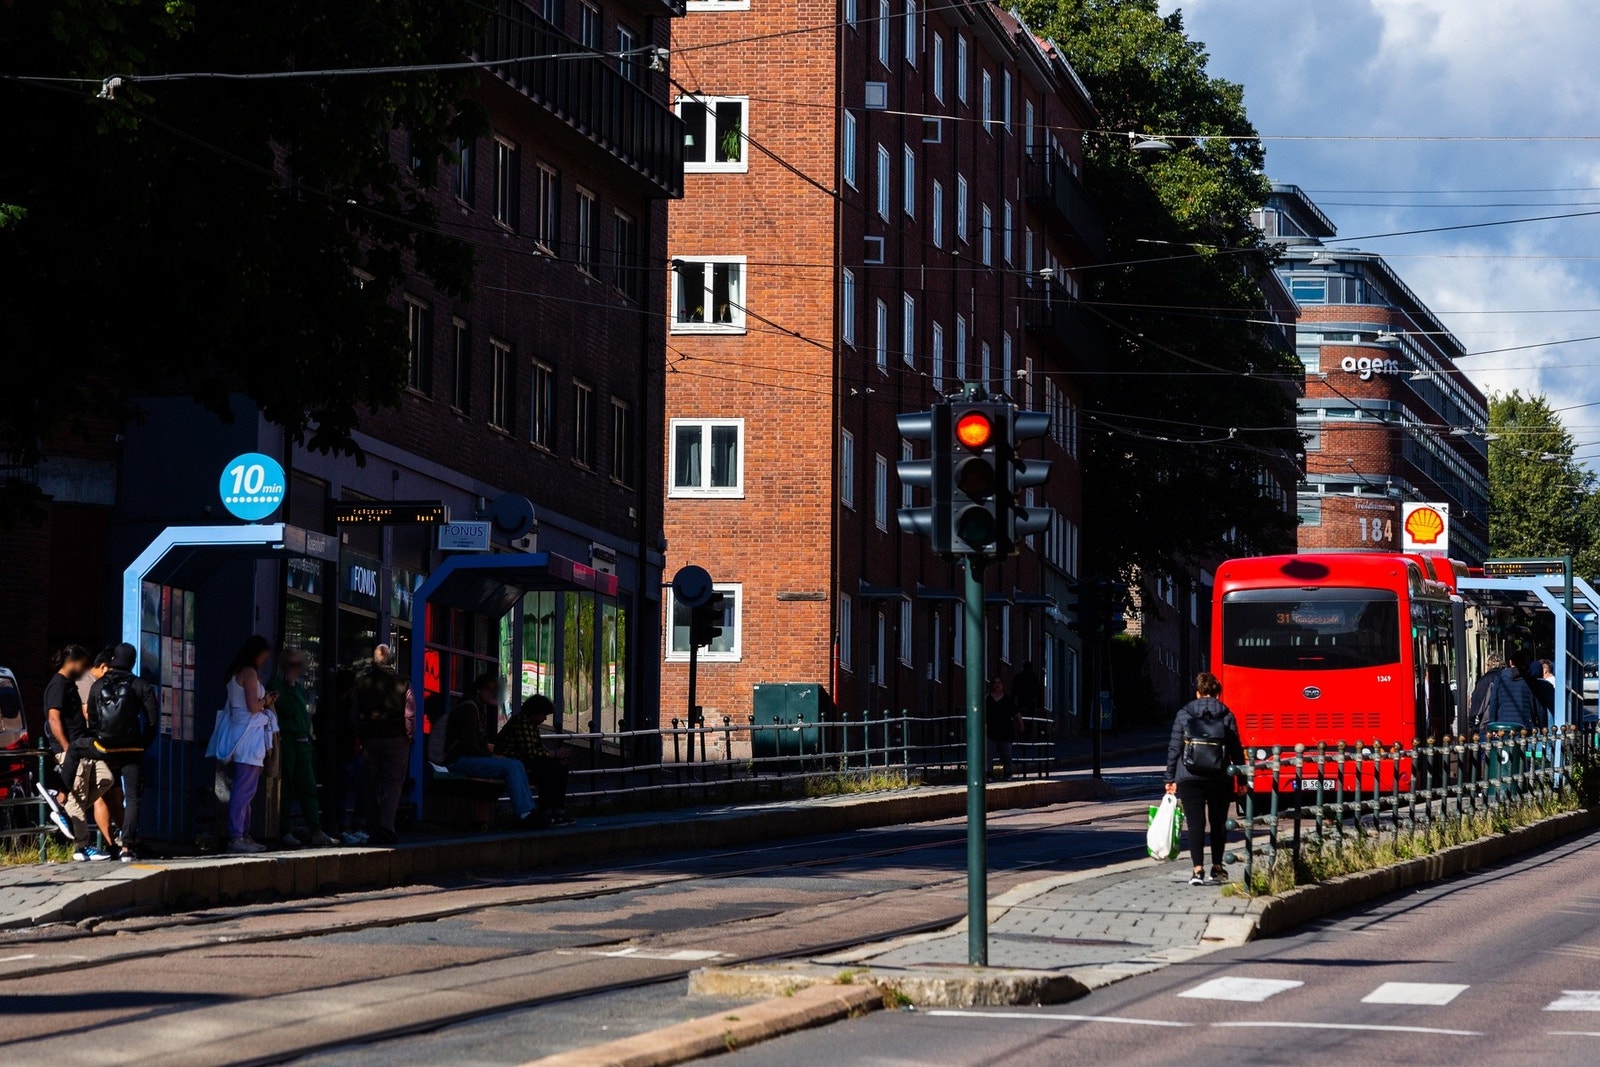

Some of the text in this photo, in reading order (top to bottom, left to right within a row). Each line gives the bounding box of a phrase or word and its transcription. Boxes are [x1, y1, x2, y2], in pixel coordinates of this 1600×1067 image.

[1341, 356, 1399, 380] agens
[230, 464, 282, 494] 10 min
[445, 525, 483, 537] FONUS
[1359, 517, 1393, 542] 184
[354, 565, 377, 598] FONUS
[1276, 612, 1291, 624] 31
